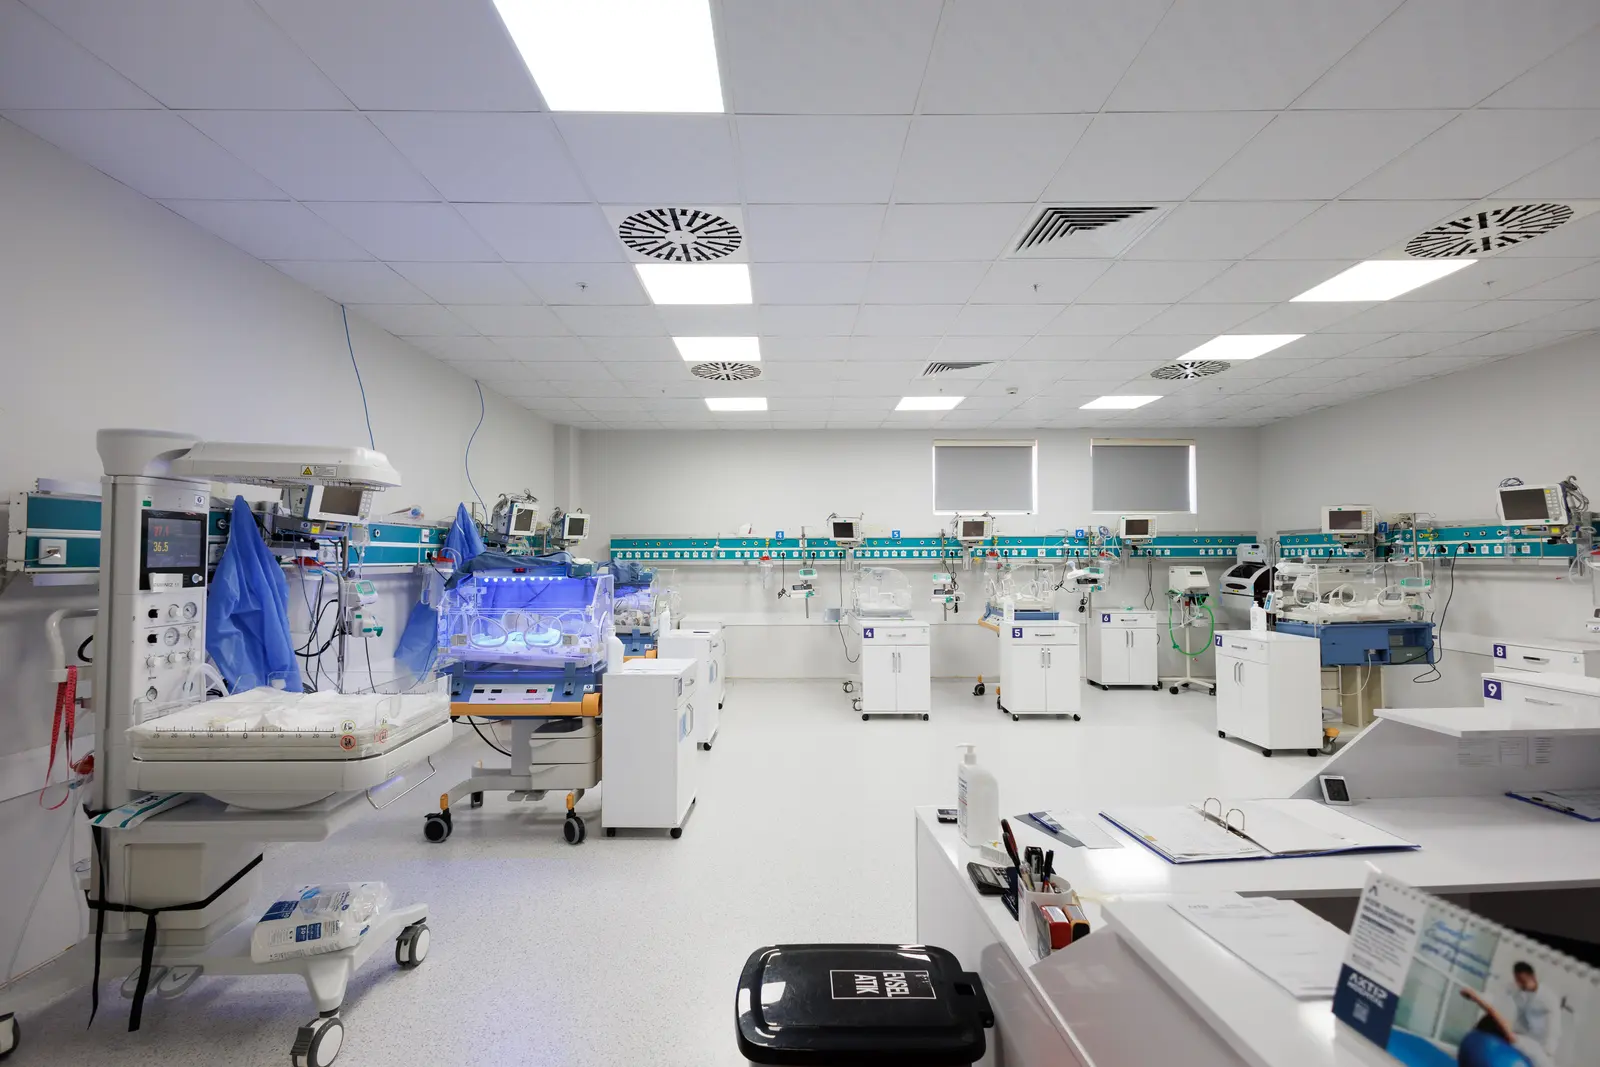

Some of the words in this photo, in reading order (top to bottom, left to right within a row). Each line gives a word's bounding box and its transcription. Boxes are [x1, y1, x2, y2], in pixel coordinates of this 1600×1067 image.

[153, 541, 169, 552] 36.5
[1103, 614, 1109, 622] 6
[865, 629, 872, 638] 4
[1014, 629, 1020, 637] 5
[1216, 635, 1221, 645] 7
[1496, 647, 1503, 657] 8
[1488, 683, 1497, 697] 9
[854, 974, 880, 994] ATIK
[882, 972, 910, 997] EVSEL
